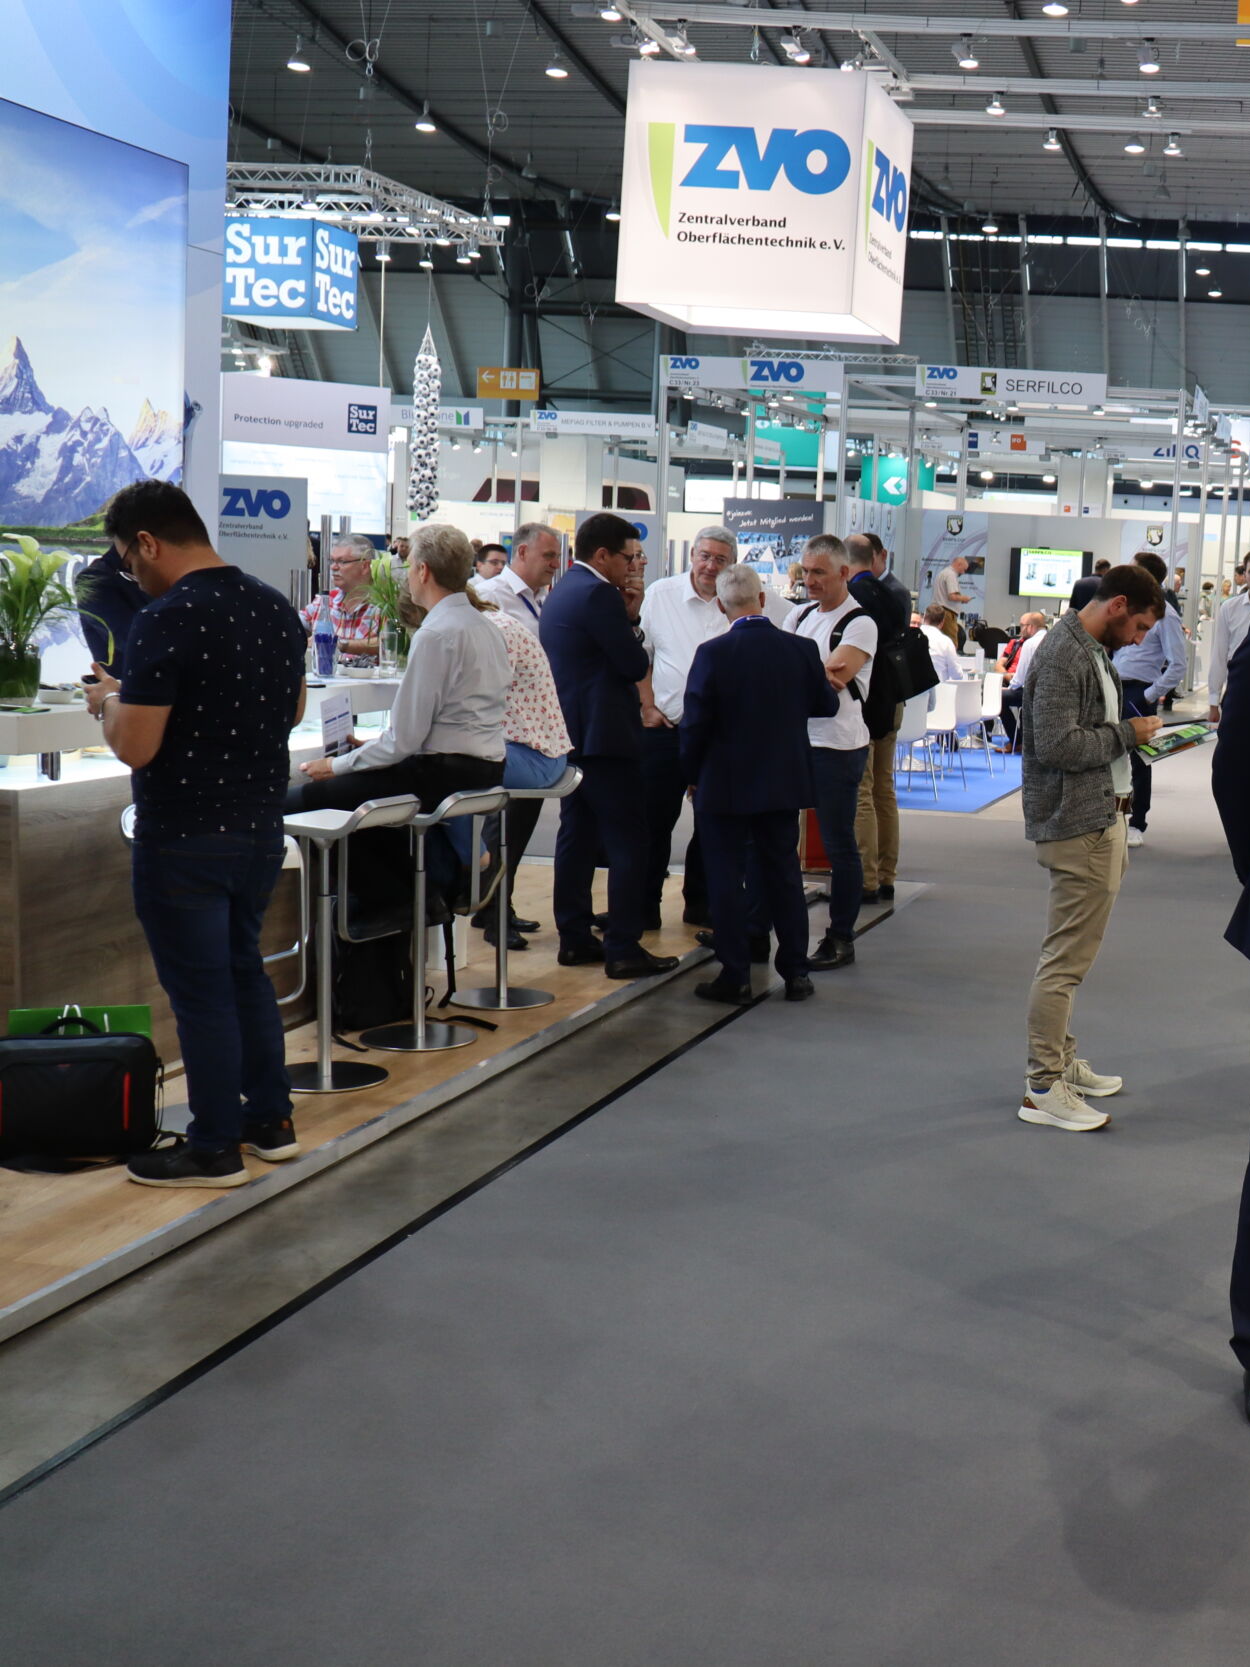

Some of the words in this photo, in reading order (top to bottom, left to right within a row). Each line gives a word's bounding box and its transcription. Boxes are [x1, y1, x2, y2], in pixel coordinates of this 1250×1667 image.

[680, 124, 851, 195] ZVO
[872, 146, 907, 233] ZVO
[678, 212, 787, 228] Zentralverband
[226, 223, 306, 265] Sur
[677, 231, 816, 249] Oberflächentechnik
[315, 228, 355, 278] Sur
[225, 267, 306, 308] Tec
[315, 272, 354, 319] Tec
[670, 357, 700, 370] ZVO
[750, 360, 804, 383] ZVO
[927, 367, 958, 380] ZVO
[1006, 379, 1083, 395] SERFILCO
[234, 413, 281, 426] Protection
[284, 419, 324, 430] upgraded
[350, 406, 375, 420] Sur
[537, 411, 557, 420] ZVO
[350, 419, 375, 433] Tec
[220, 487, 291, 519] ZVO
